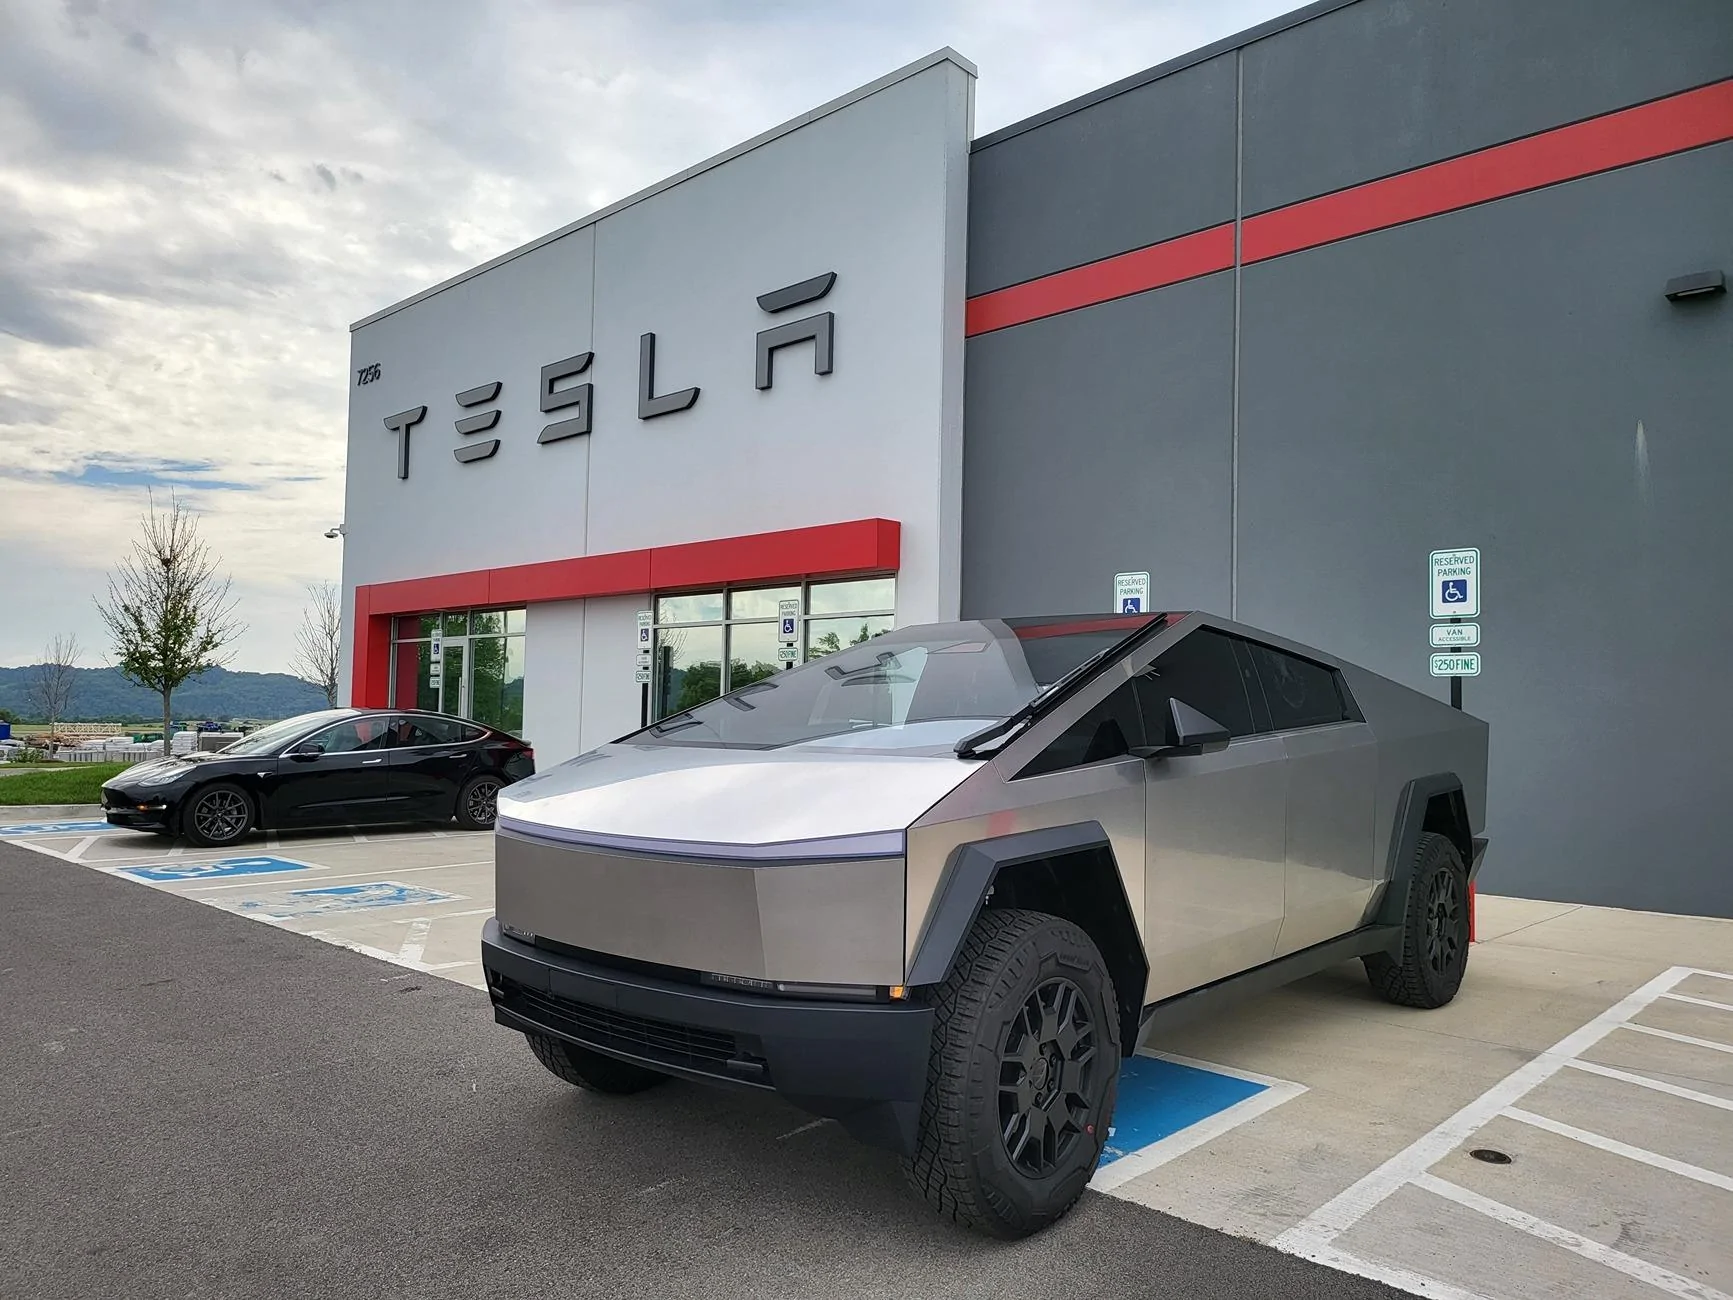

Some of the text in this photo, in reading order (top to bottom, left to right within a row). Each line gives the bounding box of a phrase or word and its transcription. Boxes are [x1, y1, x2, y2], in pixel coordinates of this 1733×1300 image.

[357, 362, 381, 386] 7256
[383, 271, 837, 479] TESLA
[1434, 555, 1475, 567] RESERVED
[1437, 566, 1471, 577] PARKING
[1118, 578, 1146, 587] RESERVED
[1120, 587, 1144, 595] PARKING
[1434, 658, 1475, 671] $250 FINE
